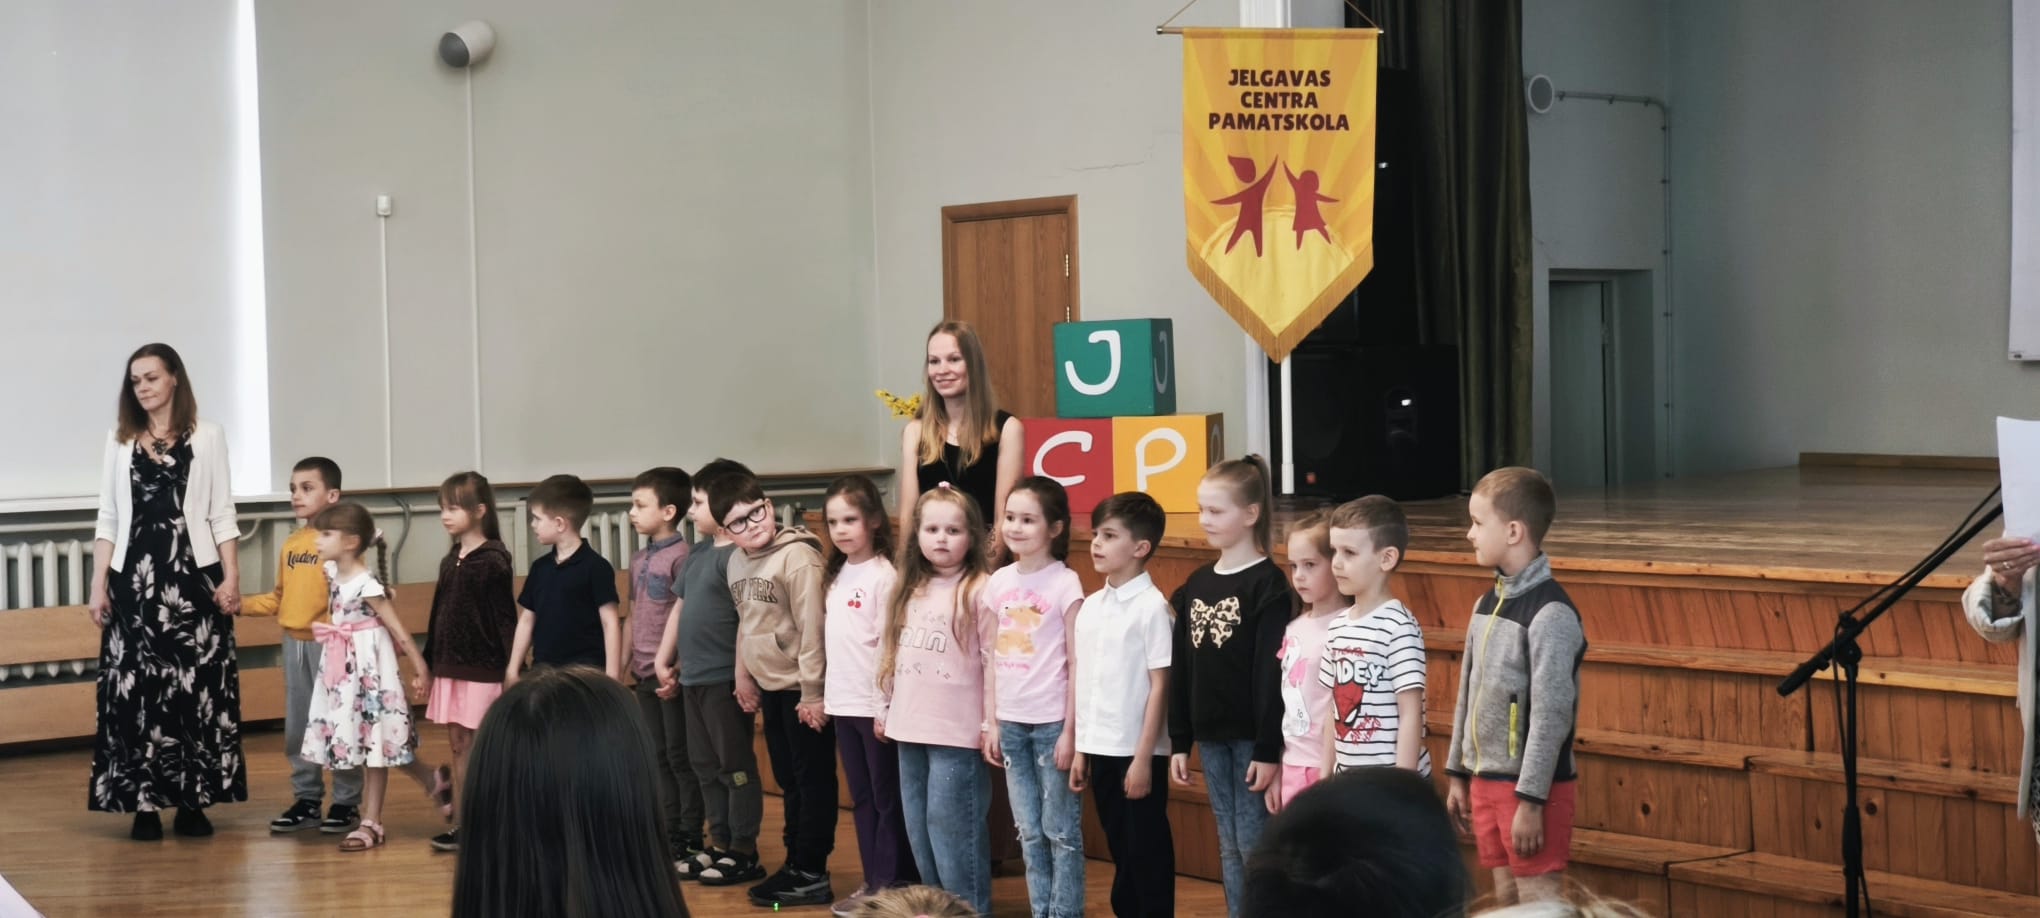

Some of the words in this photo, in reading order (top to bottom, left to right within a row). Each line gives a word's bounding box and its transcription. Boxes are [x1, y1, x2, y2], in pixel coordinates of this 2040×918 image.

[1228, 69, 1331, 87] JELGAVAS
[1240, 91, 1318, 109] CENTRA
[1209, 113, 1350, 131] PAMATSKOLA
[1064, 329, 1121, 396] J
[1153, 330, 1168, 394] J
[1033, 430, 1093, 487] C
[1135, 427, 1187, 493] P
[1335, 659, 1384, 687] IDEY
